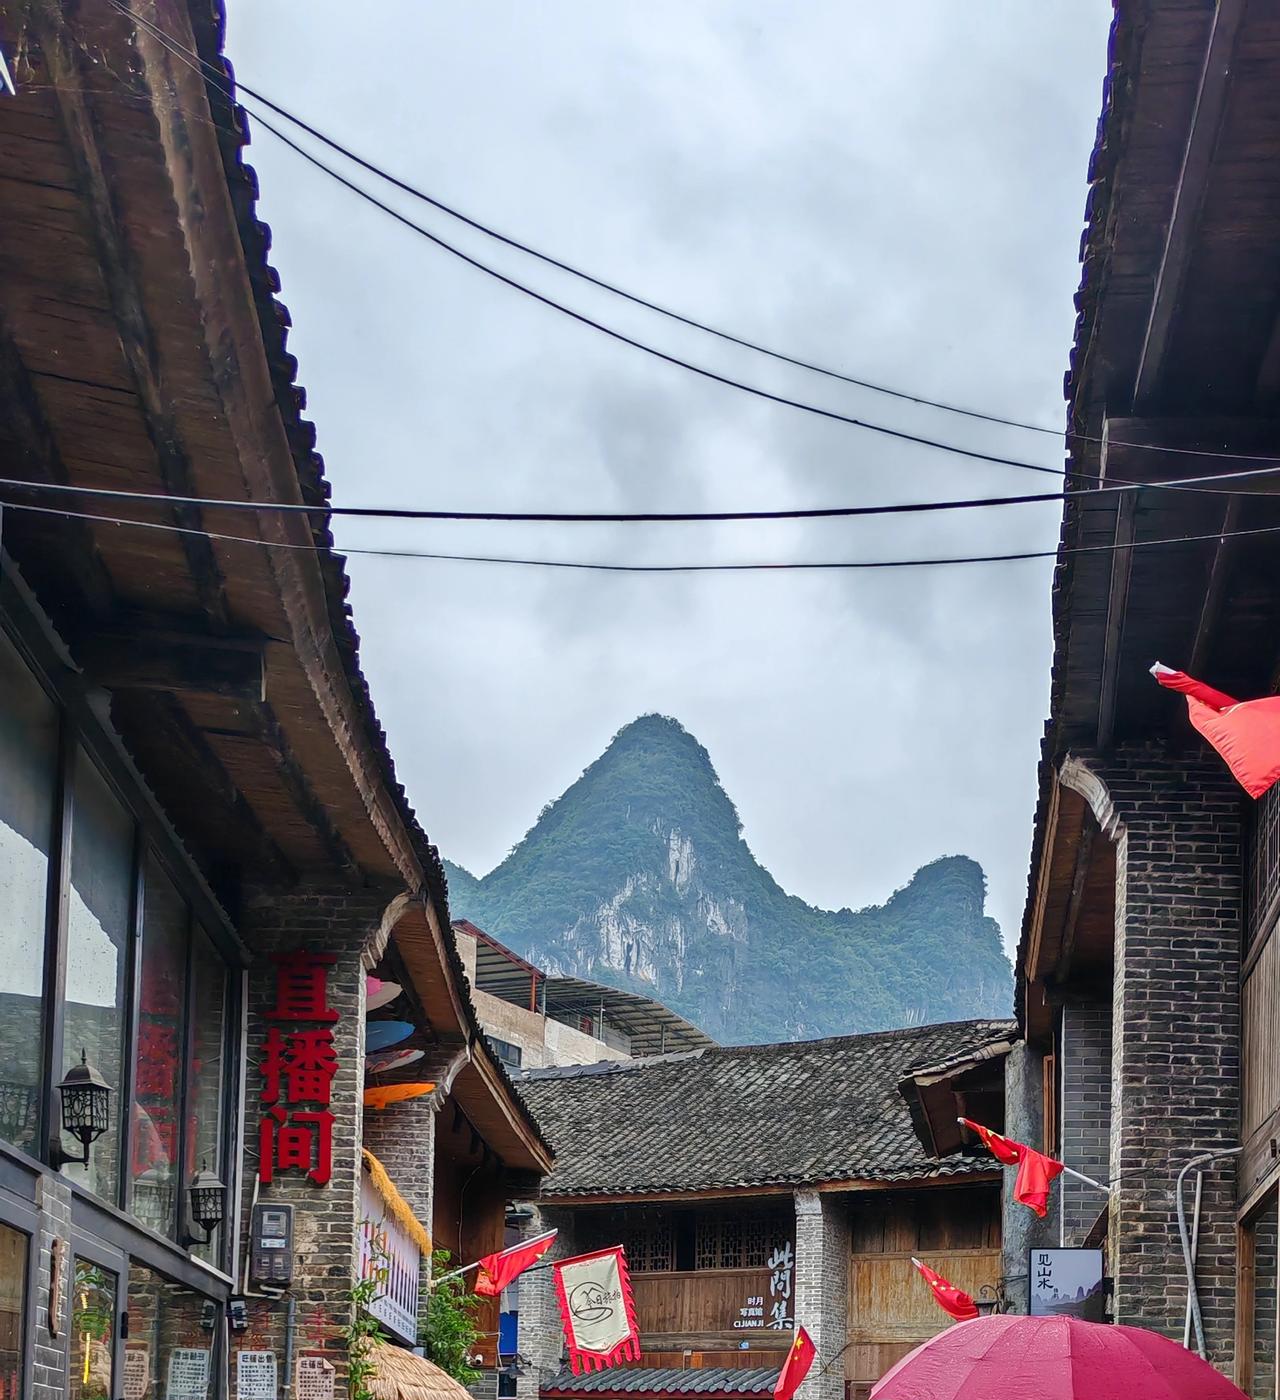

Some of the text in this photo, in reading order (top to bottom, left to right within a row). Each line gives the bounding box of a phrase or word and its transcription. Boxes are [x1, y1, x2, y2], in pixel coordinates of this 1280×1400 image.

[258, 950, 340, 1184] 直播间
[1037, 1253, 1054, 1290] 见山水
